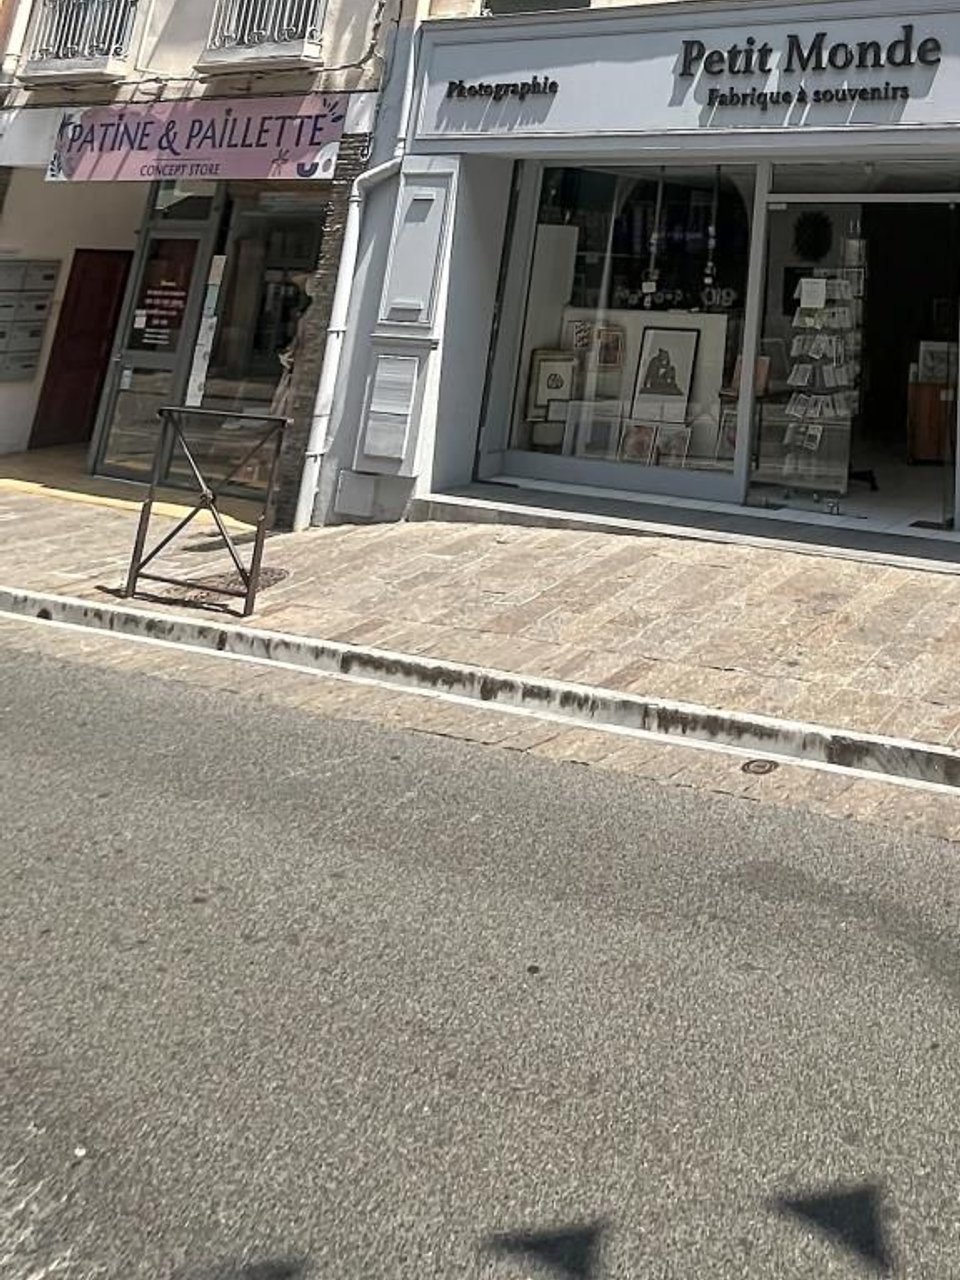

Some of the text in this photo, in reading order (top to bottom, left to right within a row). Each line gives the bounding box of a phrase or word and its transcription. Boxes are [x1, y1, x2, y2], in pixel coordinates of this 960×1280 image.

[679, 24, 941, 76] Petit Monde
[446, 75, 559, 101] Photographie
[707, 82, 909, 111] Fabrique à souvenirs
[66, 108, 327, 156] PATINE & PAILLETTE
[140, 163, 221, 177] CONCEPT STORE
